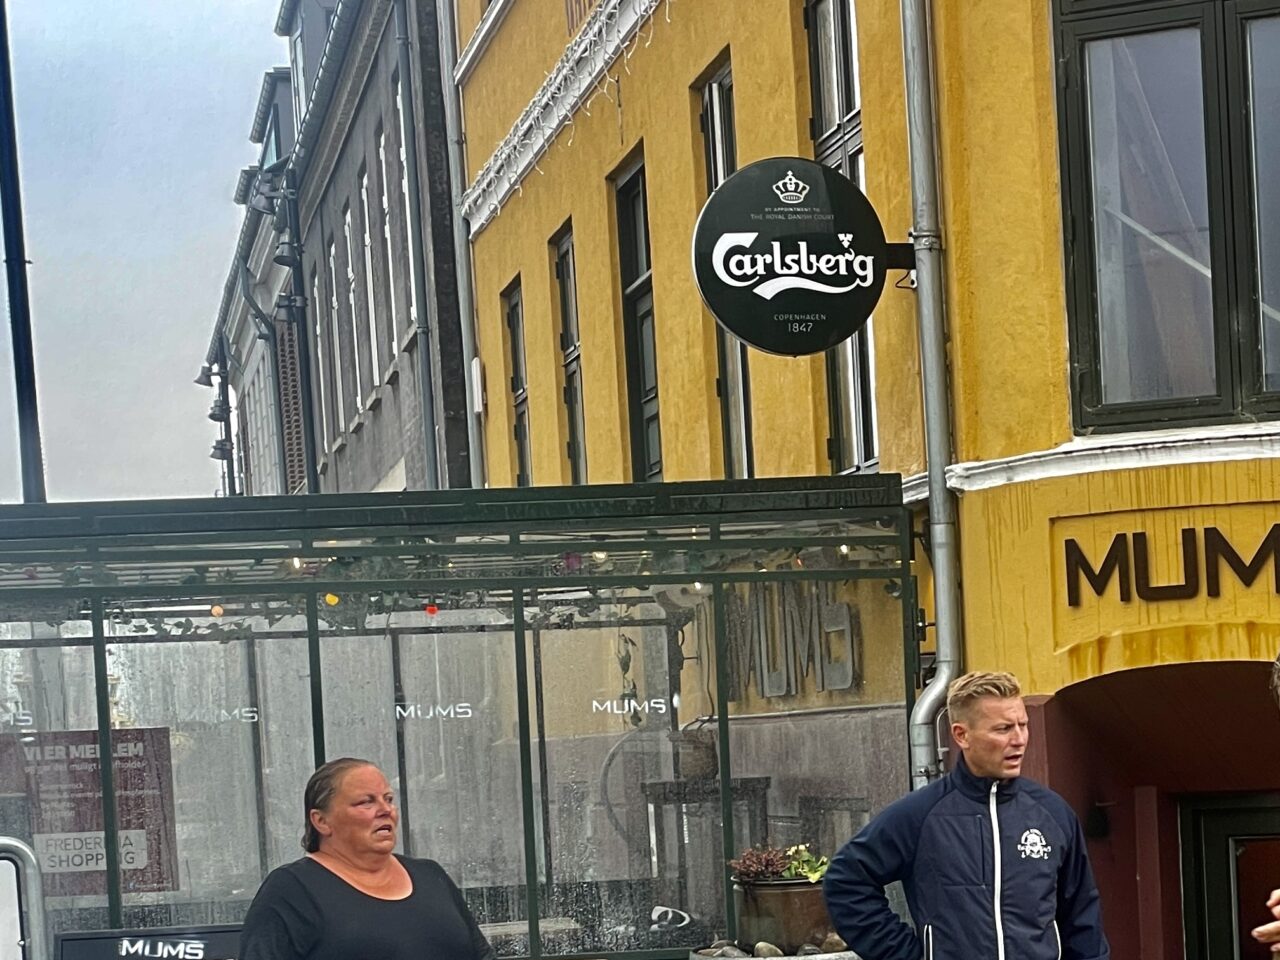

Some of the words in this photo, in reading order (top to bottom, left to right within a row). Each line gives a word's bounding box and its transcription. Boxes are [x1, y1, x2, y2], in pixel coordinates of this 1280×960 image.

[712, 232, 875, 300] Carlsberg
[788, 322, 813, 332] 1847
[396, 703, 472, 719] MUMS
[592, 699, 666, 714] MUMS
[24, 747, 41, 760] VI
[44, 745, 66, 760] ER
[69, 743, 144, 759] MEEM
[46, 835, 133, 852] FREDERA
[47, 851, 135, 867] SHOPPG
[121, 939, 204, 960] MUMS
